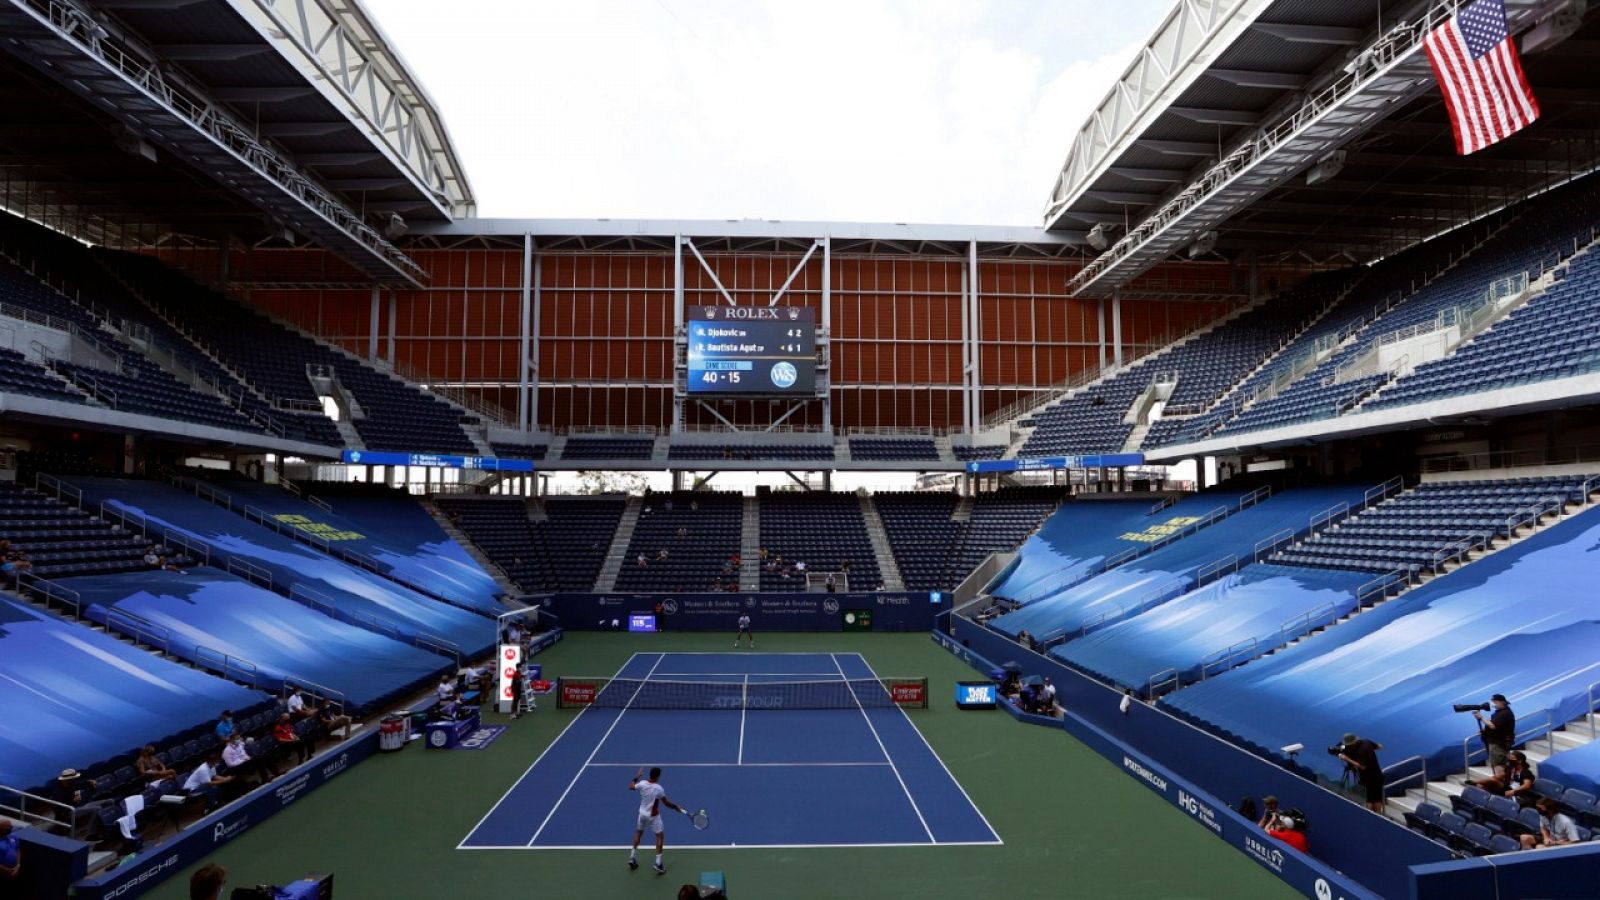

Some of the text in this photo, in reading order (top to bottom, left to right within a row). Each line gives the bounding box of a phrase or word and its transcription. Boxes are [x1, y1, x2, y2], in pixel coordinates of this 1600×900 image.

[725, 308, 780, 319] ROLEX
[708, 328, 738, 338] Djokovic
[787, 329, 793, 337] 4
[795, 329, 802, 337] 2
[708, 344, 738, 352] Bautista
[739, 344, 757, 353] Agut
[705, 361, 720, 370] GAME
[702, 372, 717, 383] 40
[728, 372, 740, 383] 15
[564, 686, 595, 695] Emirates
[893, 686, 922, 696] Emirates
[710, 695, 742, 708] ATP
[1178, 789, 1197, 815] IHG
[103, 854, 179, 900] PORSCHE
